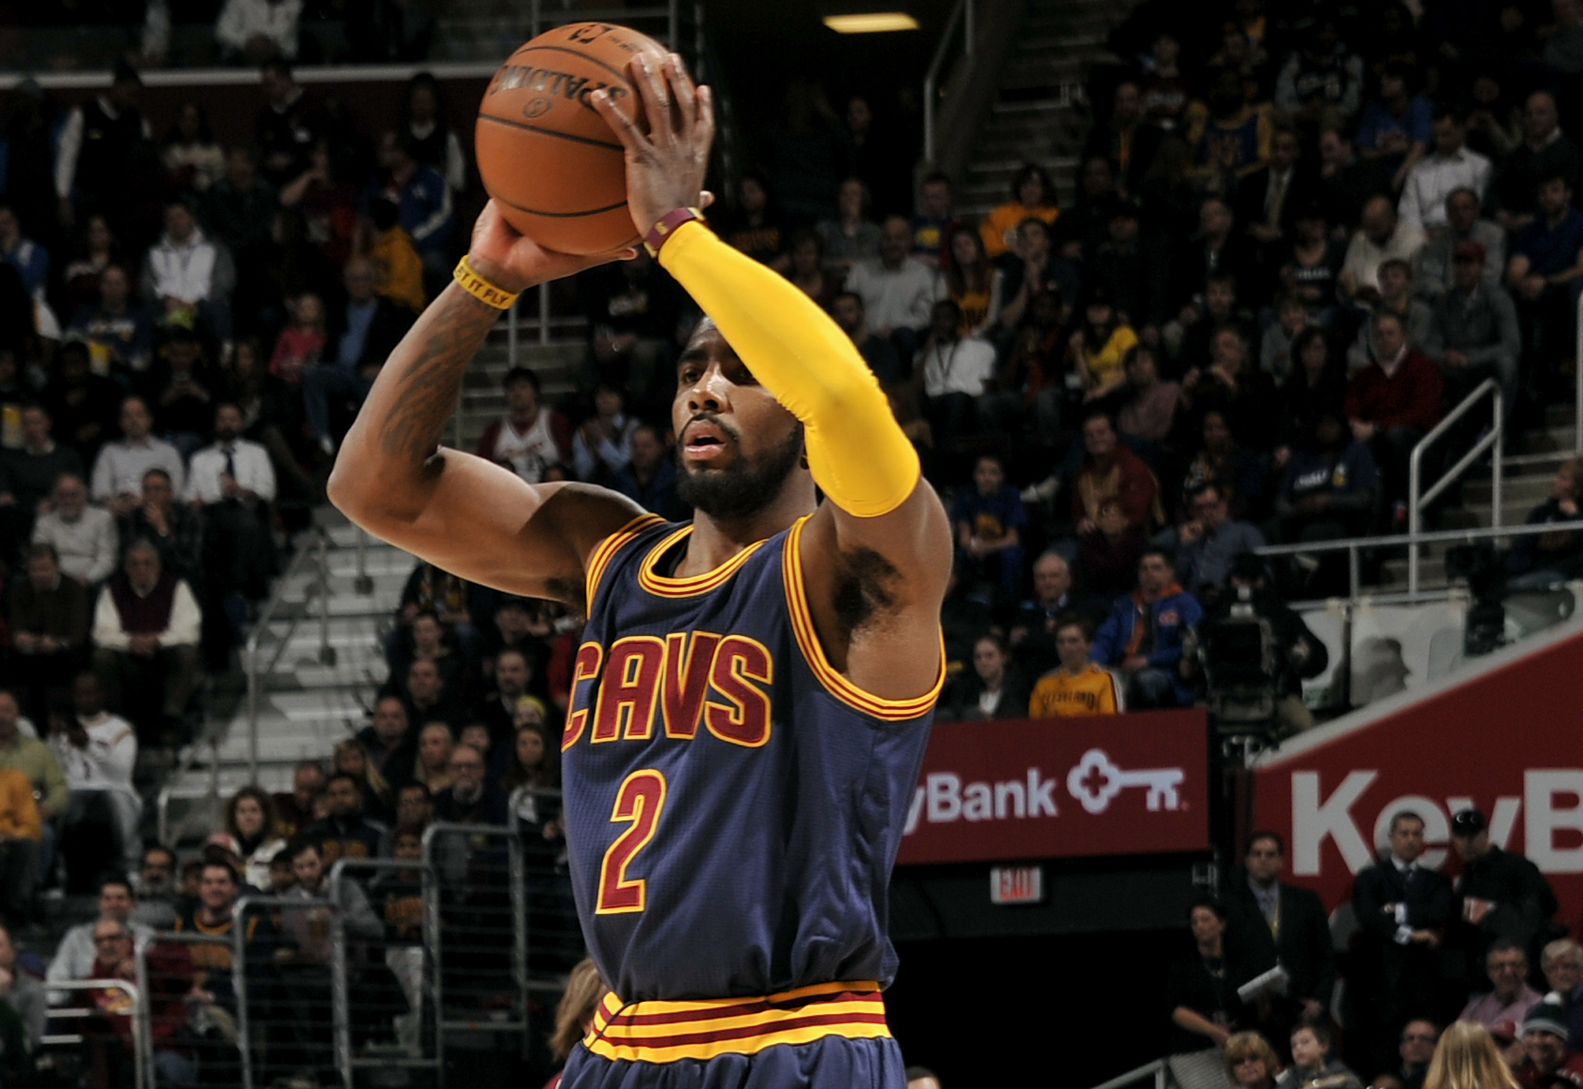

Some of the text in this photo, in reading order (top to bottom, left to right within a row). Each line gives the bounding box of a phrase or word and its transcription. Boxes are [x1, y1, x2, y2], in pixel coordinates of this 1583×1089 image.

[483, 288, 510, 306] FLY
[561, 630, 773, 752] CAVS
[595, 769, 666, 915] 2
